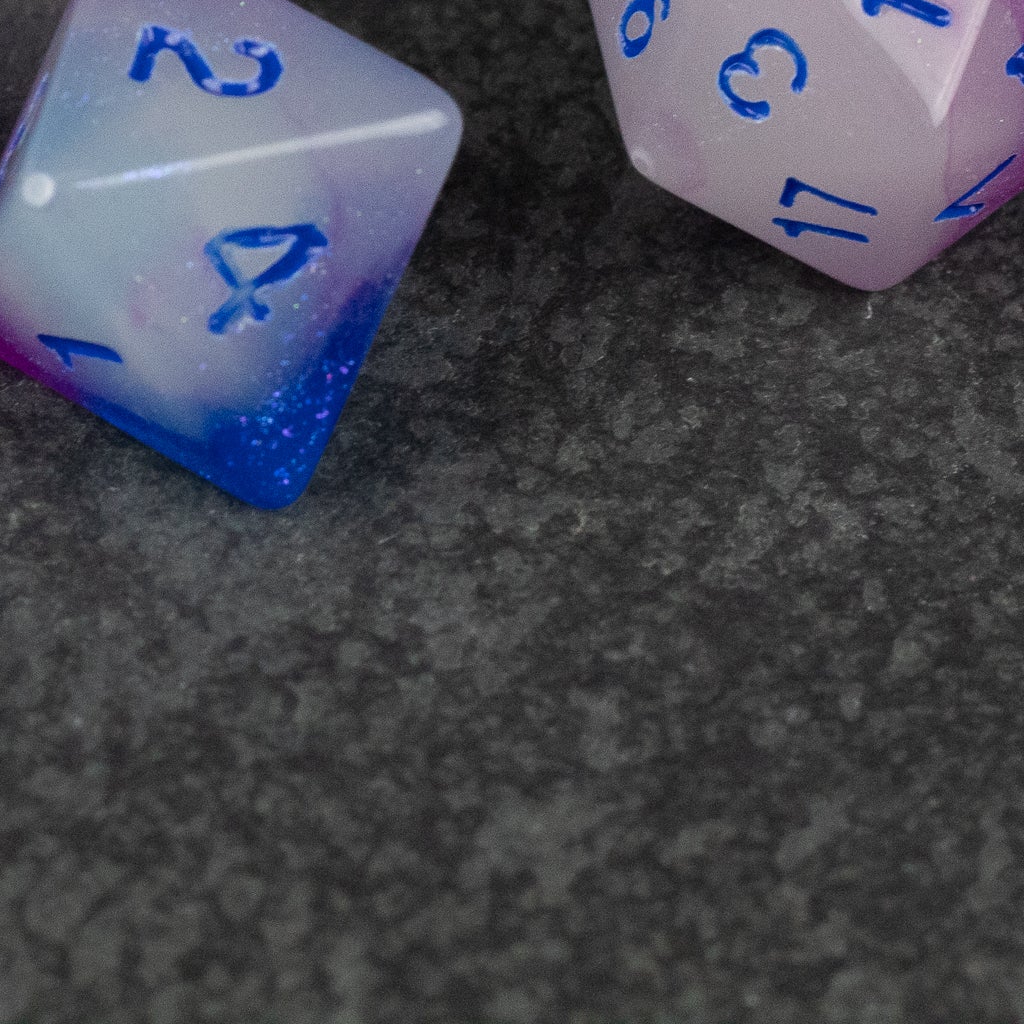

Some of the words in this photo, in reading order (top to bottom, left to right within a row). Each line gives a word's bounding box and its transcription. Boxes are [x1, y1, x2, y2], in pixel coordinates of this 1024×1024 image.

[128, 25, 285, 98] 2
[717, 27, 808, 122] 3
[772, 176, 878, 244] 17
[204, 223, 328, 336] 4
[37, 333, 123, 372] 1
